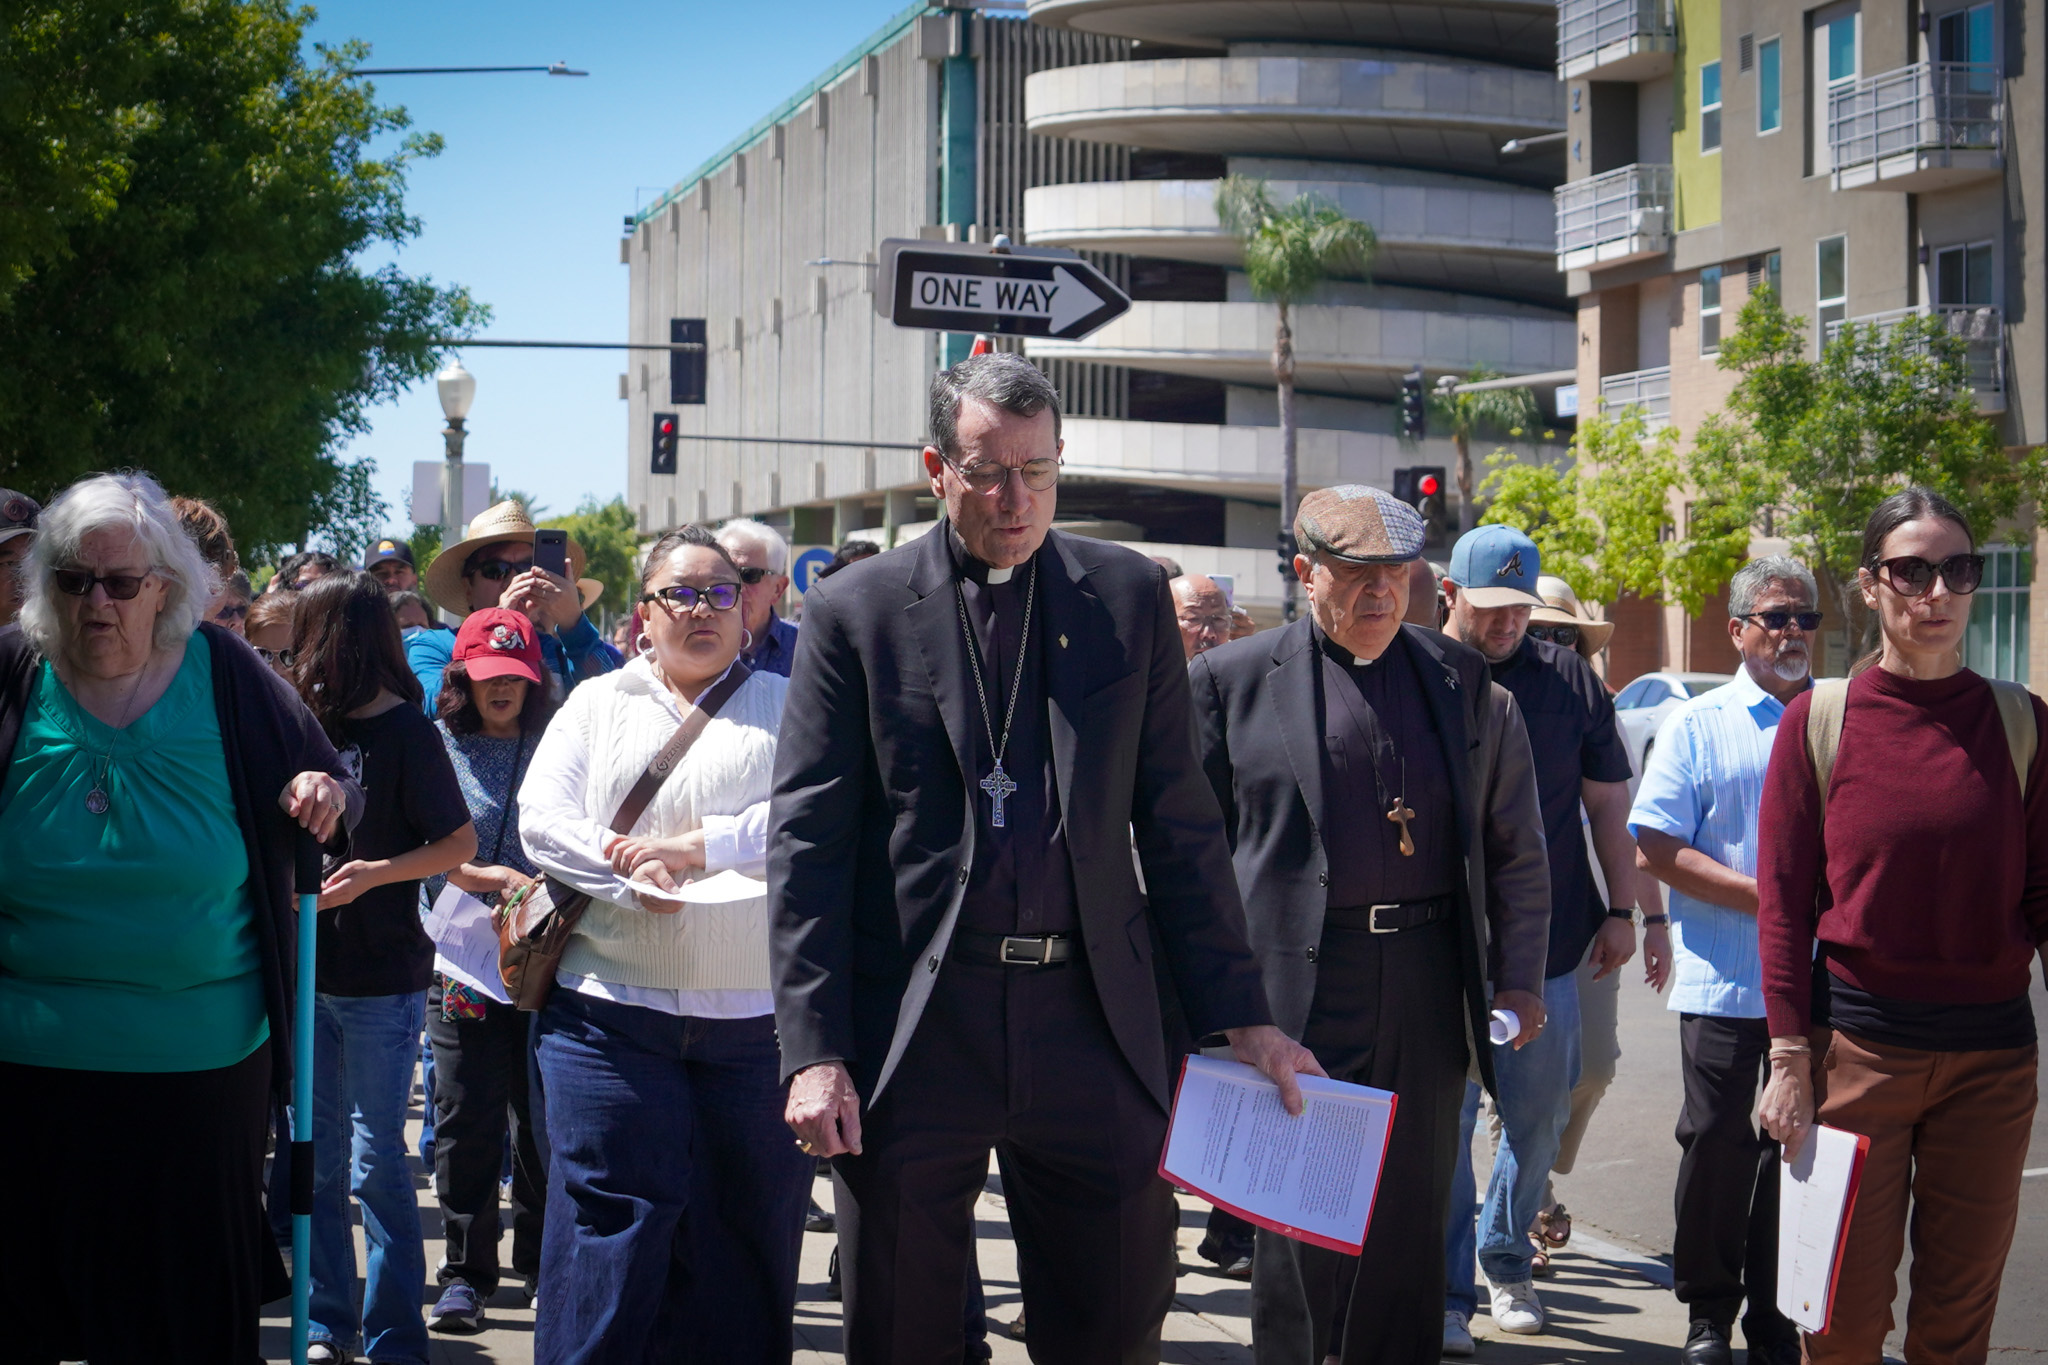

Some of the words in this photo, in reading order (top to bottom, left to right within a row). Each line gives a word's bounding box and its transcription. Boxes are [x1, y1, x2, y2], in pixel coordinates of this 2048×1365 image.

[920, 276, 982, 308] ONE
[996, 281, 1060, 313] WAY
[1497, 551, 1523, 576] A
